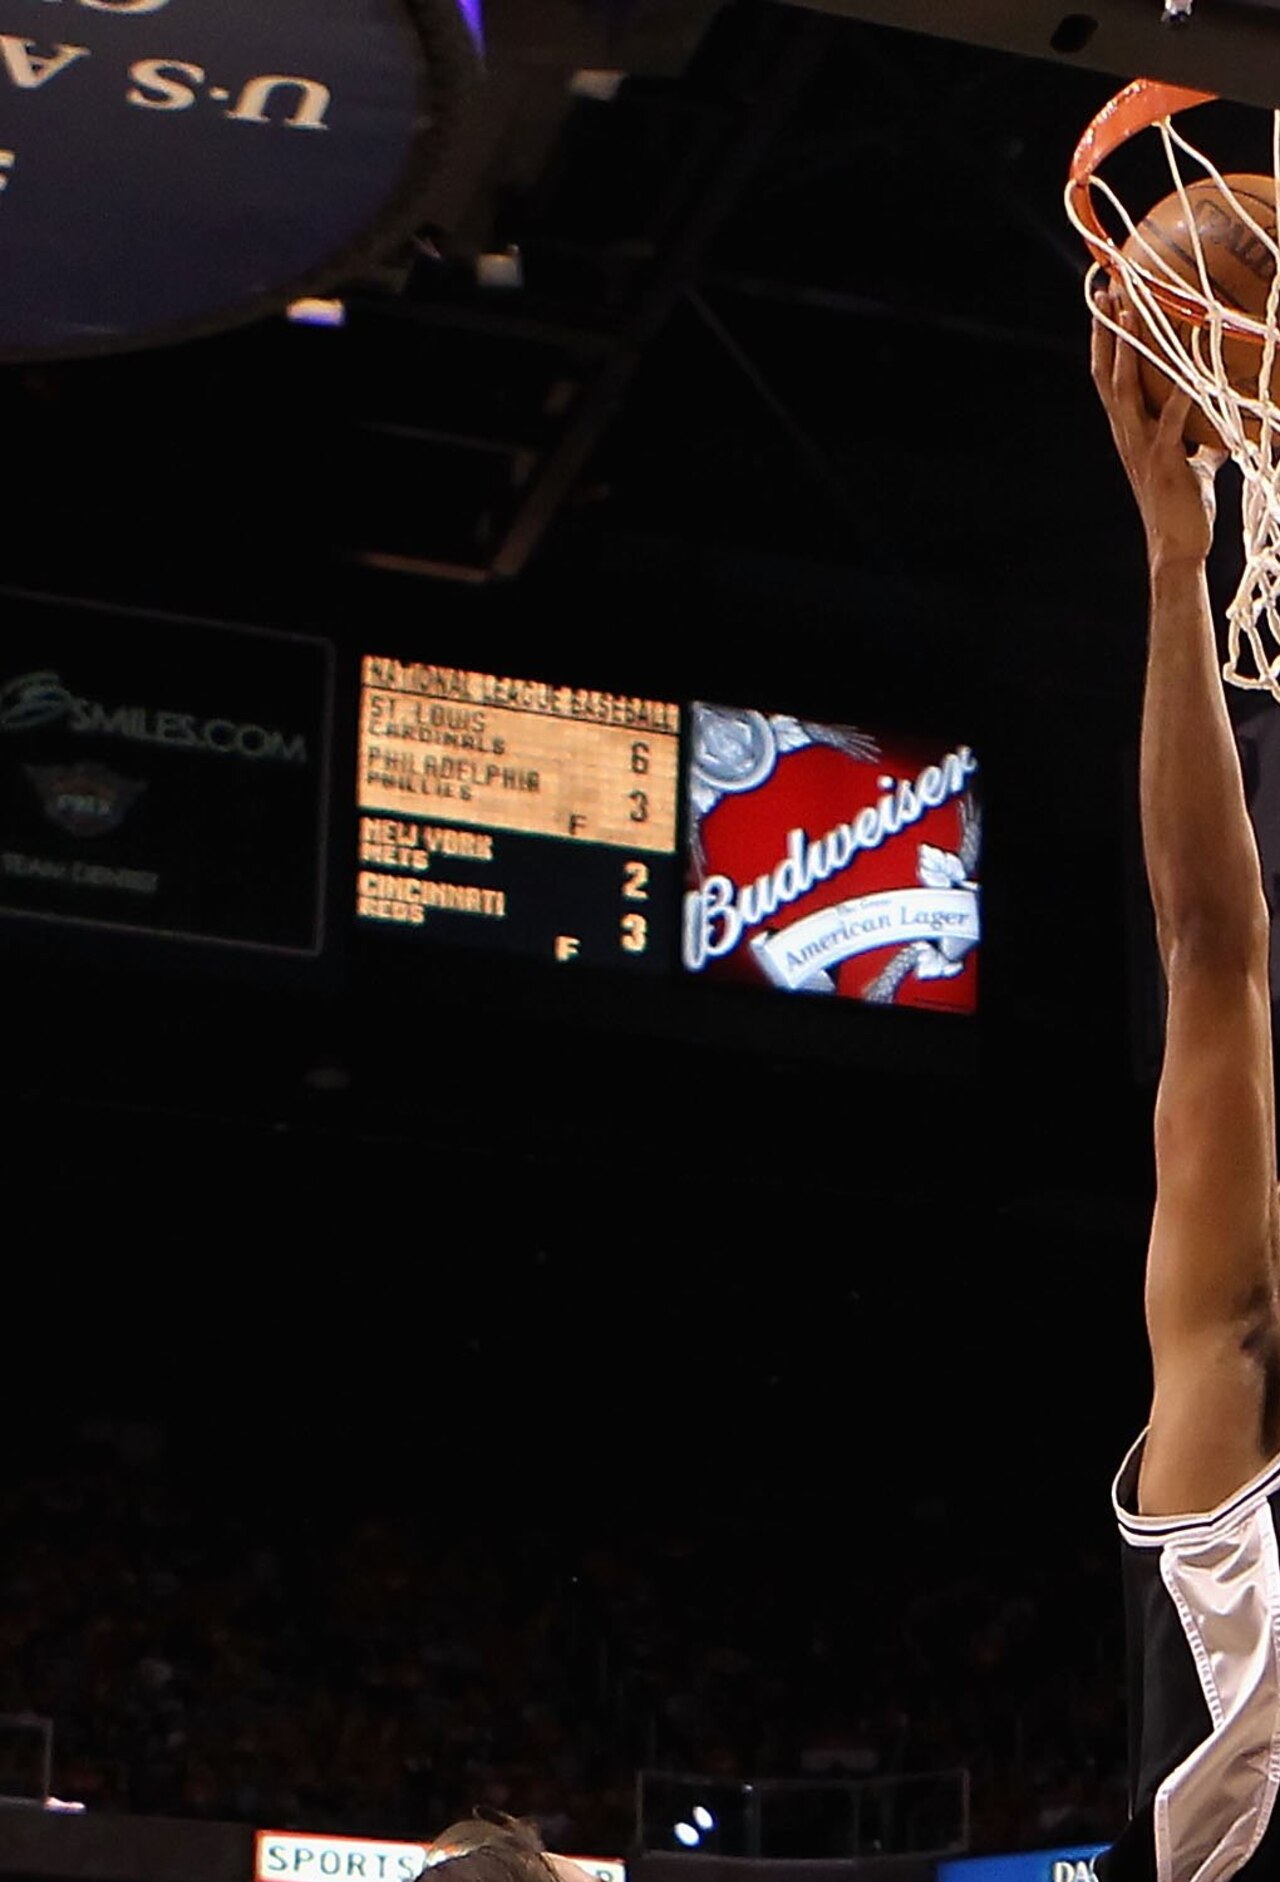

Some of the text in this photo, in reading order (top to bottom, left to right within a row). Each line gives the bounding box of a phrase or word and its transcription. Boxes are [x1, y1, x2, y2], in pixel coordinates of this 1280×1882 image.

[414, 702, 487, 733] LOUIS
[369, 745, 541, 793] PHILADELPHIA
[630, 740, 650, 775] 6
[568, 813, 587, 836] F
[629, 789, 649, 823] 3
[682, 743, 979, 972] Budweiser
[357, 869, 506, 917] CINCINNATI
[622, 860, 649, 900] 2
[554, 934, 581, 962] F
[619, 912, 648, 953] 3
[783, 911, 893, 973] American
[899, 904, 969, 931] Lager
